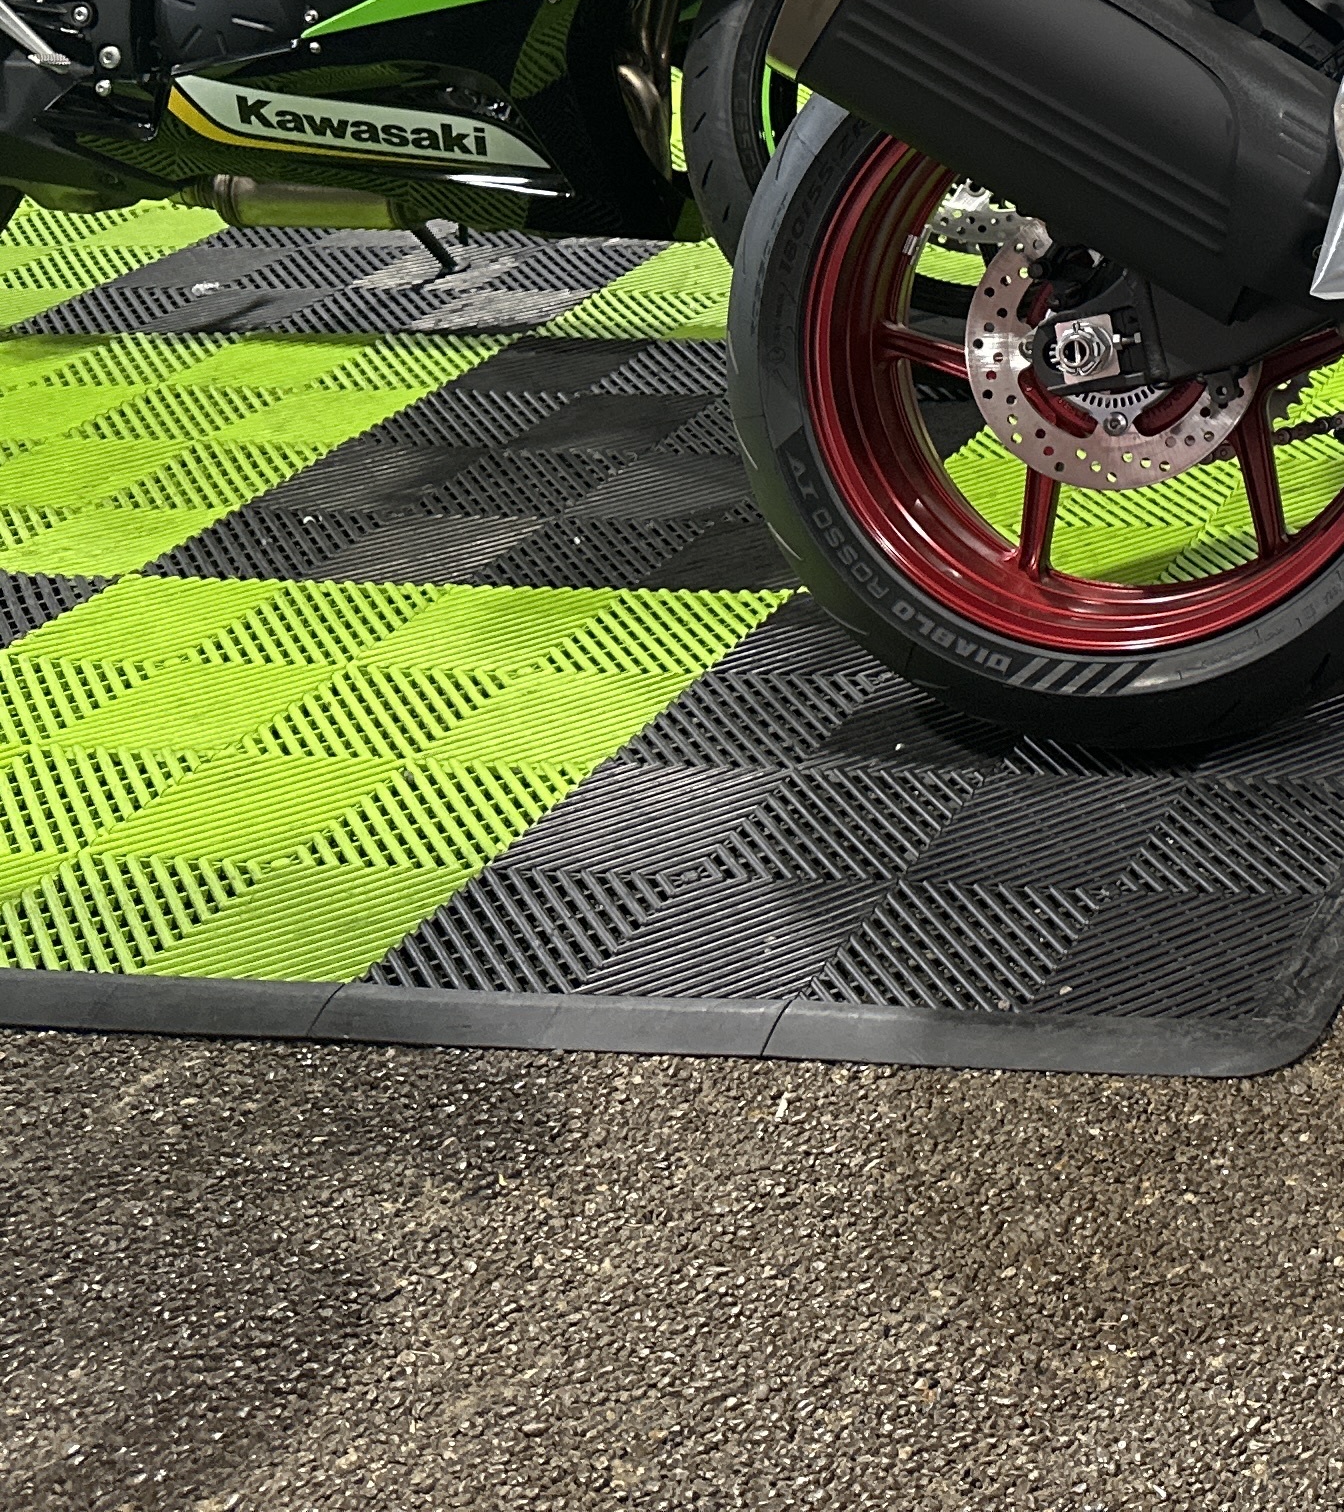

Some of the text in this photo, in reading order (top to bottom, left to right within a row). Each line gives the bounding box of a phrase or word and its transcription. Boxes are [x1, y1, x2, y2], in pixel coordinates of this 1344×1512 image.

[235, 94, 488, 159] Kawasaki
[811, 508, 890, 600] ROSSO
[891, 599, 1013, 675] DIABLO
